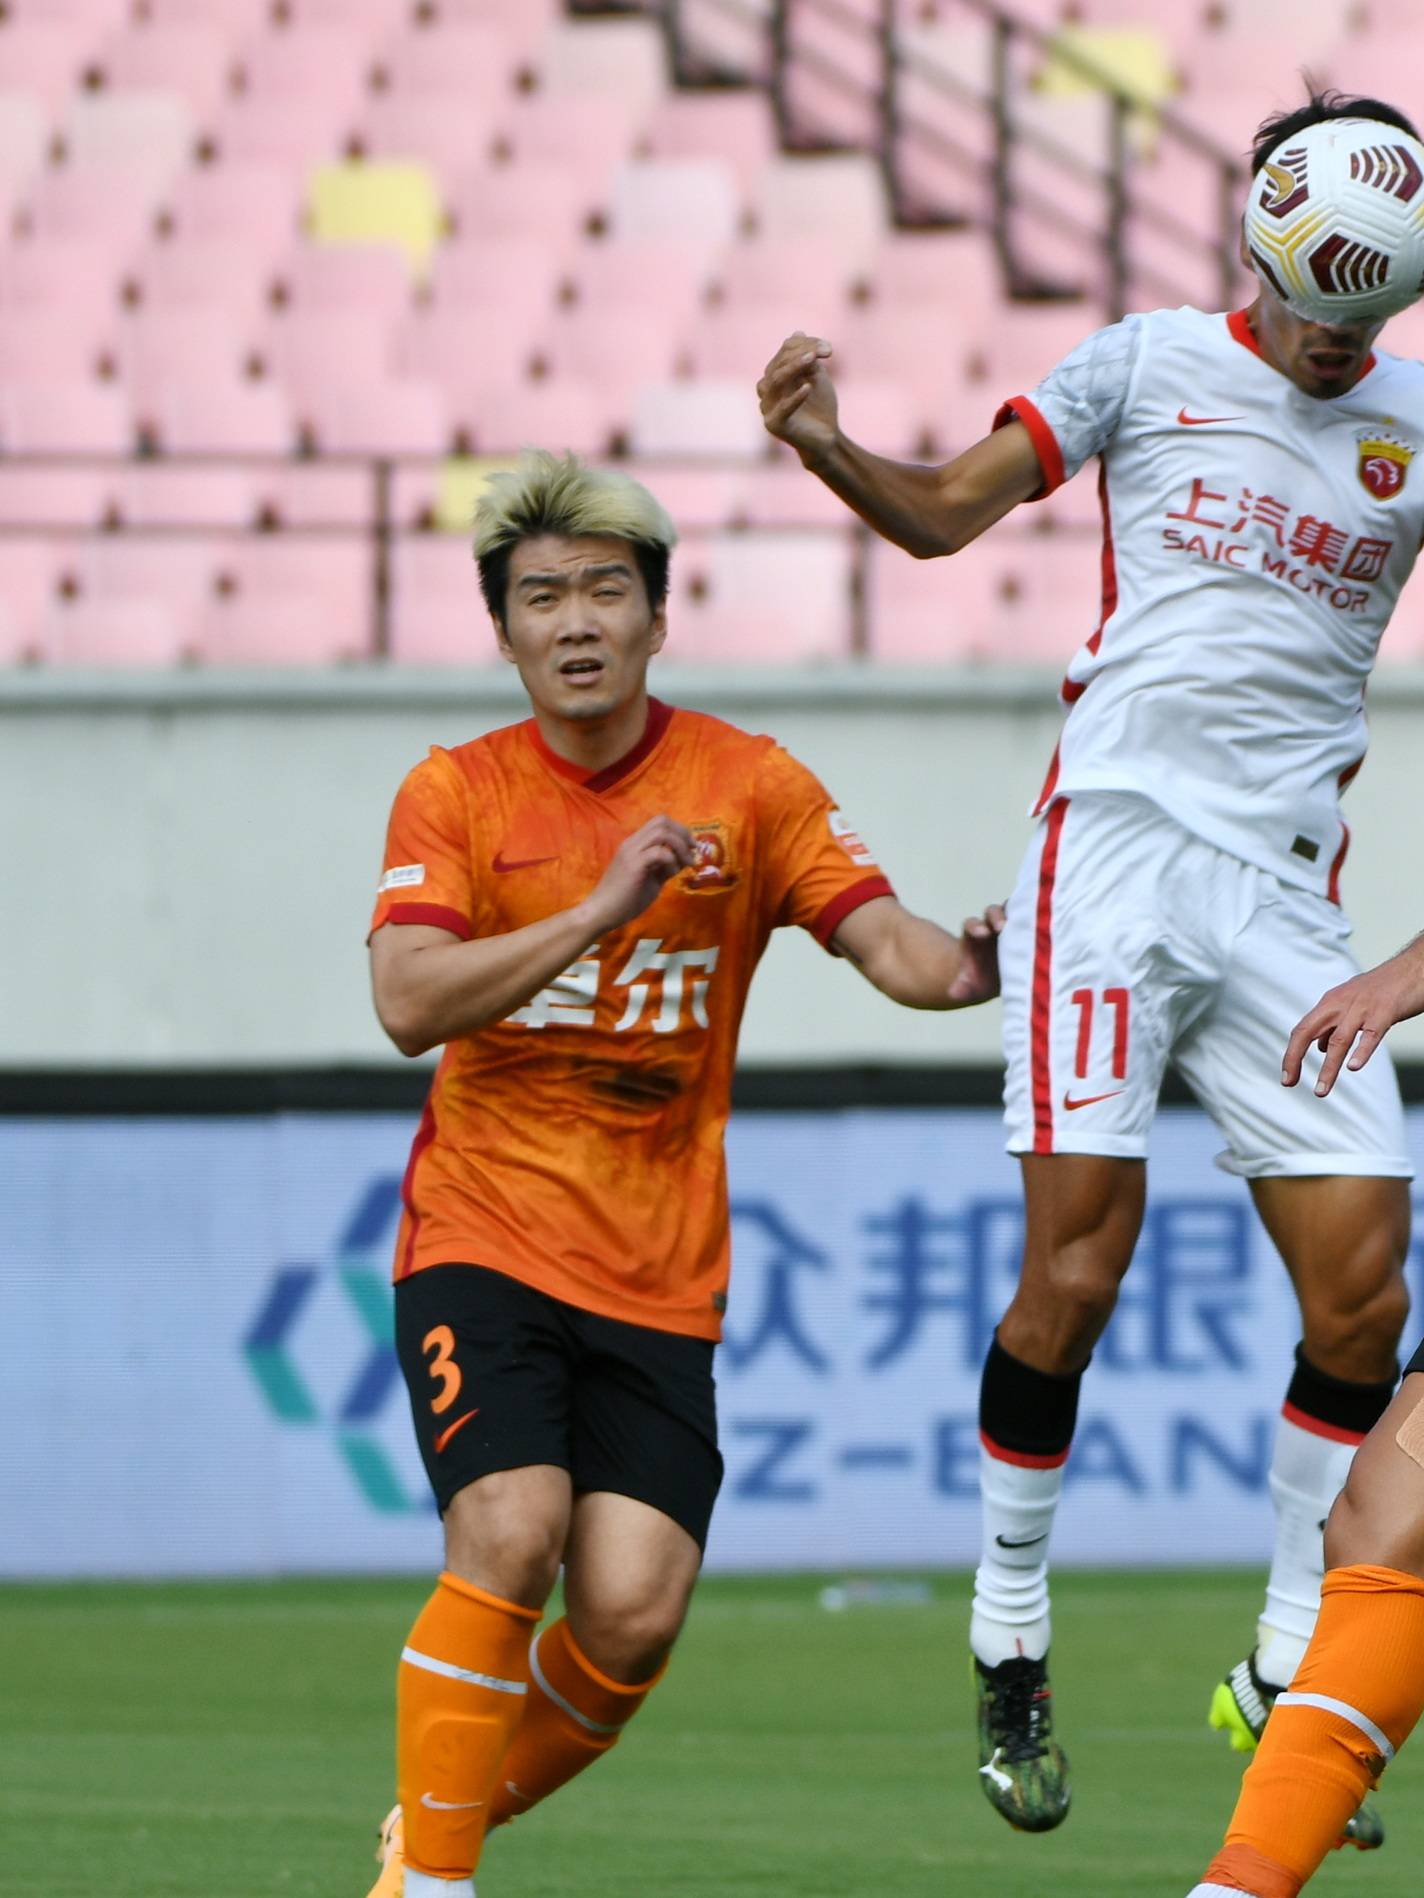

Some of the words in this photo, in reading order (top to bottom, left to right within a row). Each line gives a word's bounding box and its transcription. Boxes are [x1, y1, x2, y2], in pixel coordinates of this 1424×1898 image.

[1162, 528, 1249, 568] SAIC
[1262, 551, 1370, 613] MOTOR
[1166, 478, 1393, 582] 上汽集团
[1071, 987, 1130, 1080] 11
[422, 1324, 462, 1415] 3
